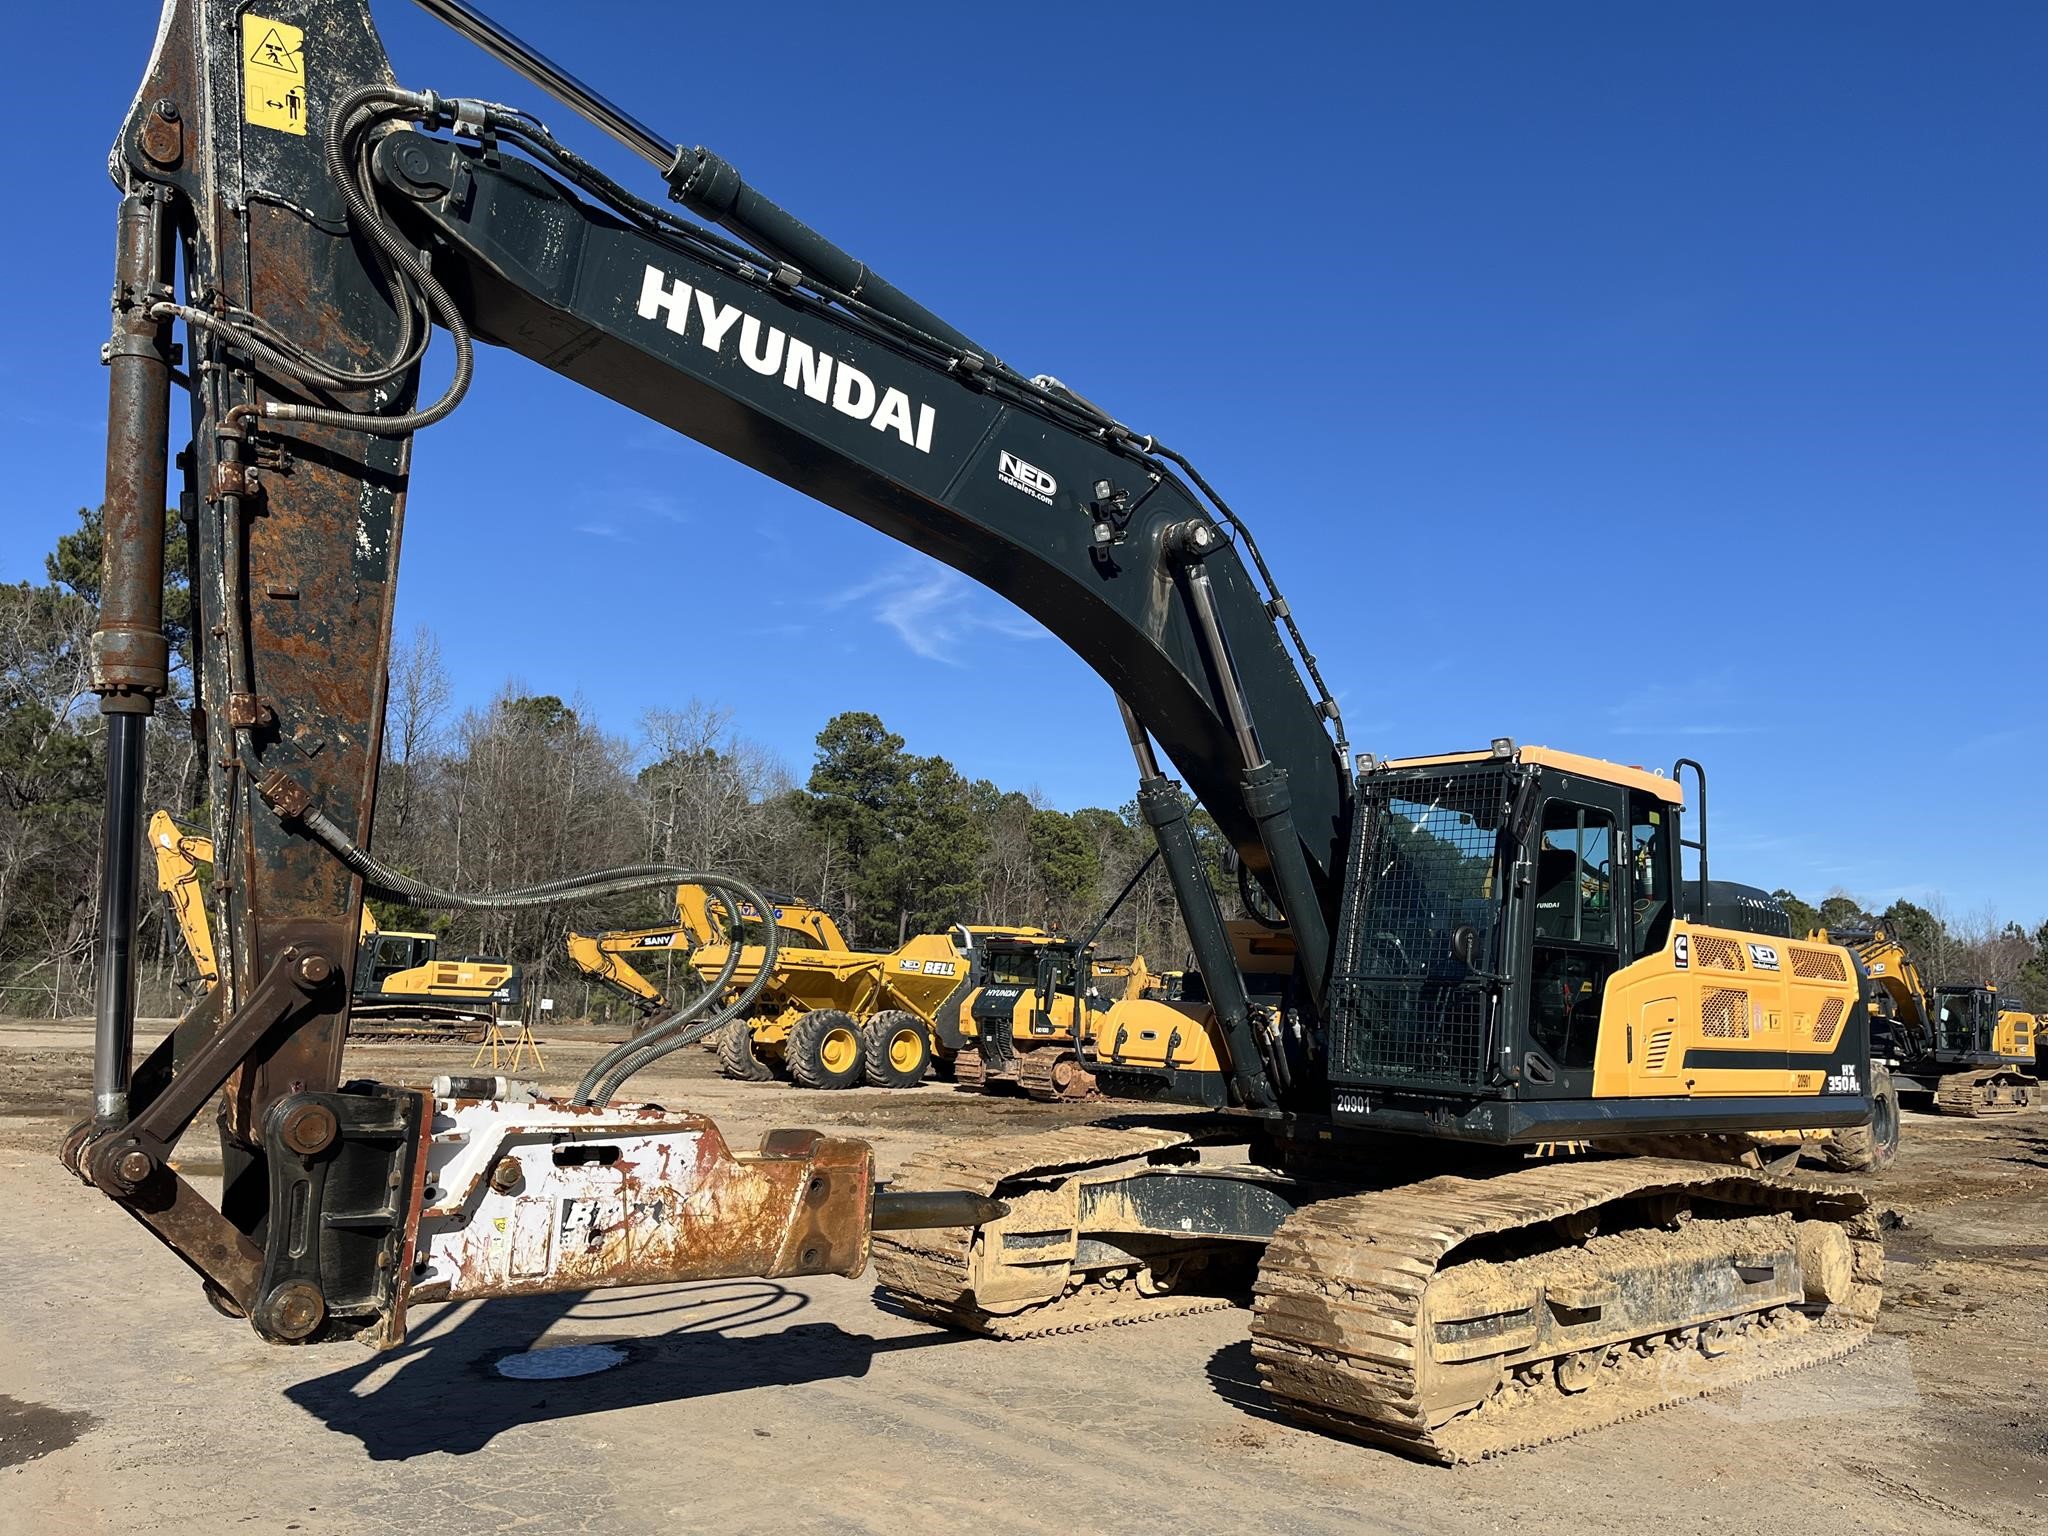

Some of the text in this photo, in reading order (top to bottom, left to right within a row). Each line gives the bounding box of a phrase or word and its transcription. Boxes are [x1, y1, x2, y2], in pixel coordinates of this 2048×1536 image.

[637, 264, 936, 454] HYUNDAI
[999, 451, 1057, 496] NED
[999, 473, 1053, 506] nedealers.com
[644, 936, 671, 946] SANY
[1747, 944, 1778, 963] NED
[900, 960, 920, 969] NED
[923, 961, 955, 976] BELL
[986, 988, 1019, 998] HYUNDAI
[1841, 1064, 1855, 1076] HX
[1828, 1075, 1861, 1092] 350AL
[1337, 1094, 1370, 1114] 20901
